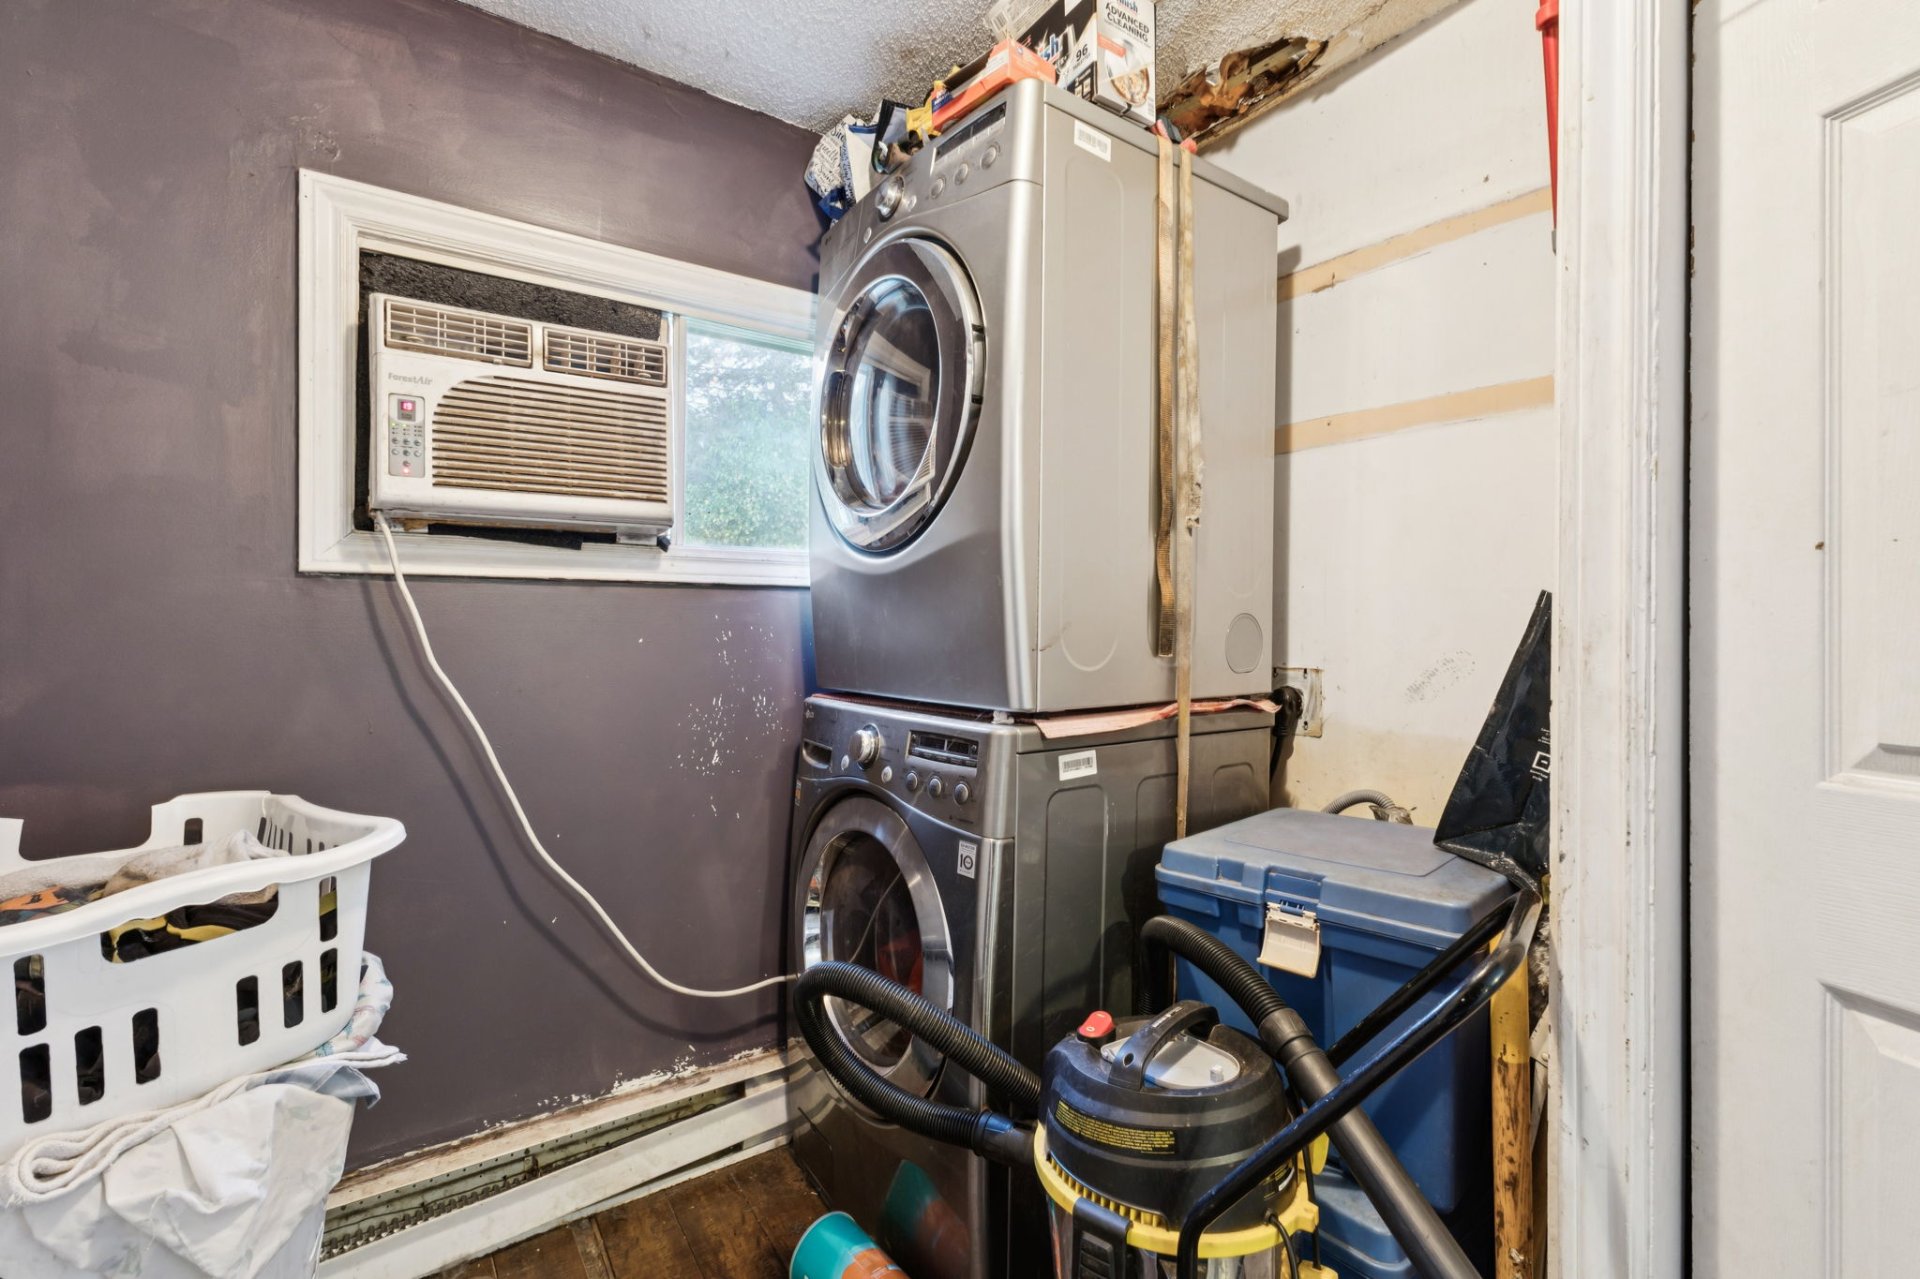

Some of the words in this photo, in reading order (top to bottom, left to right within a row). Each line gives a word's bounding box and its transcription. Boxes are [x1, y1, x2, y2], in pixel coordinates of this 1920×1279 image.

[1105, 2, 1149, 34] ADVANCED
[1106, 12, 1149, 42] CLEANING
[1076, 43, 1089, 62] 96
